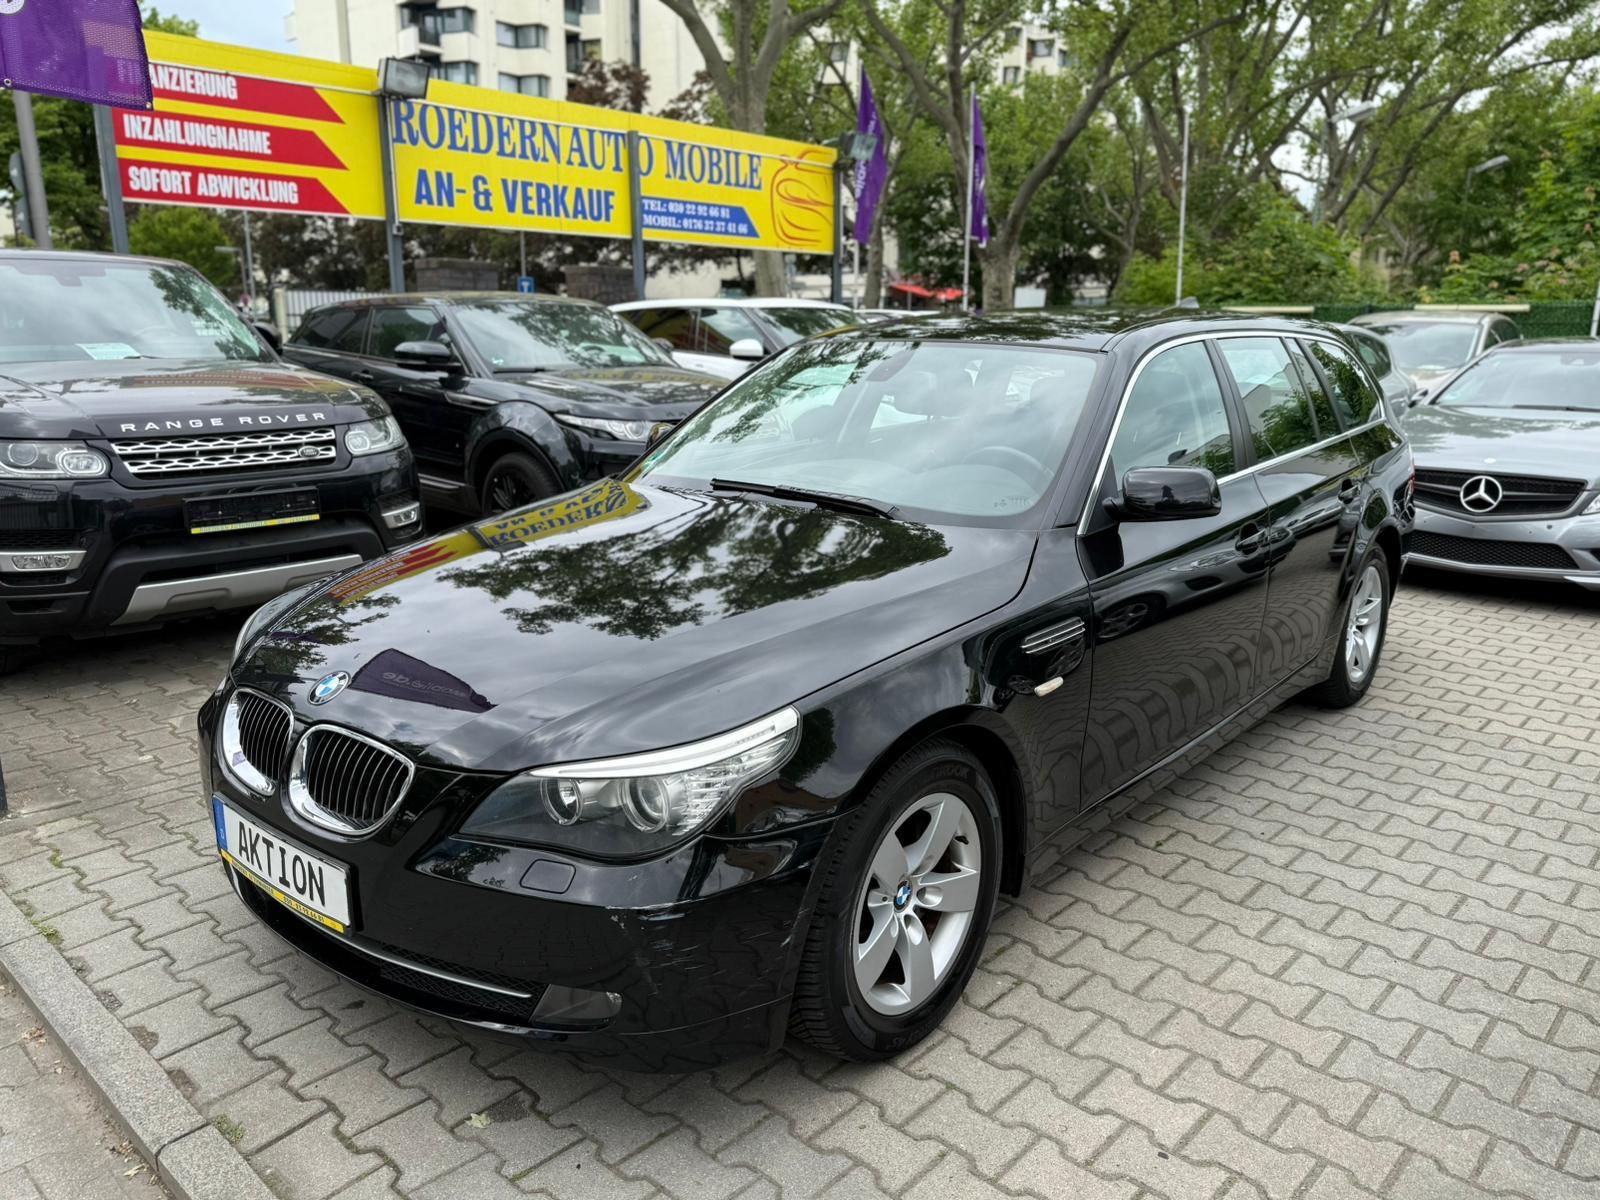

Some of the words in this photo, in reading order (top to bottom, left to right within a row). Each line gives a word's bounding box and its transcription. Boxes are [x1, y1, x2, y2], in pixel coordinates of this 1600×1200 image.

[149, 65, 238, 100] ANZIERUNG
[123, 114, 272, 154] INZAHLUNGNAHME
[664, 140, 762, 191] MOBILE
[128, 166, 192, 195] SOFORT
[197, 173, 299, 204] ABWICKLUNG
[415, 168, 466, 208] AN-
[472, 175, 493, 212] &
[501, 178, 615, 222] VERKAUF
[642, 199, 667, 212] TEL:
[642, 214, 682, 229] MOBIL:
[120, 418, 224, 433] RANGE
[238, 412, 326, 425] ROVER
[238, 821, 326, 907] AKTION
